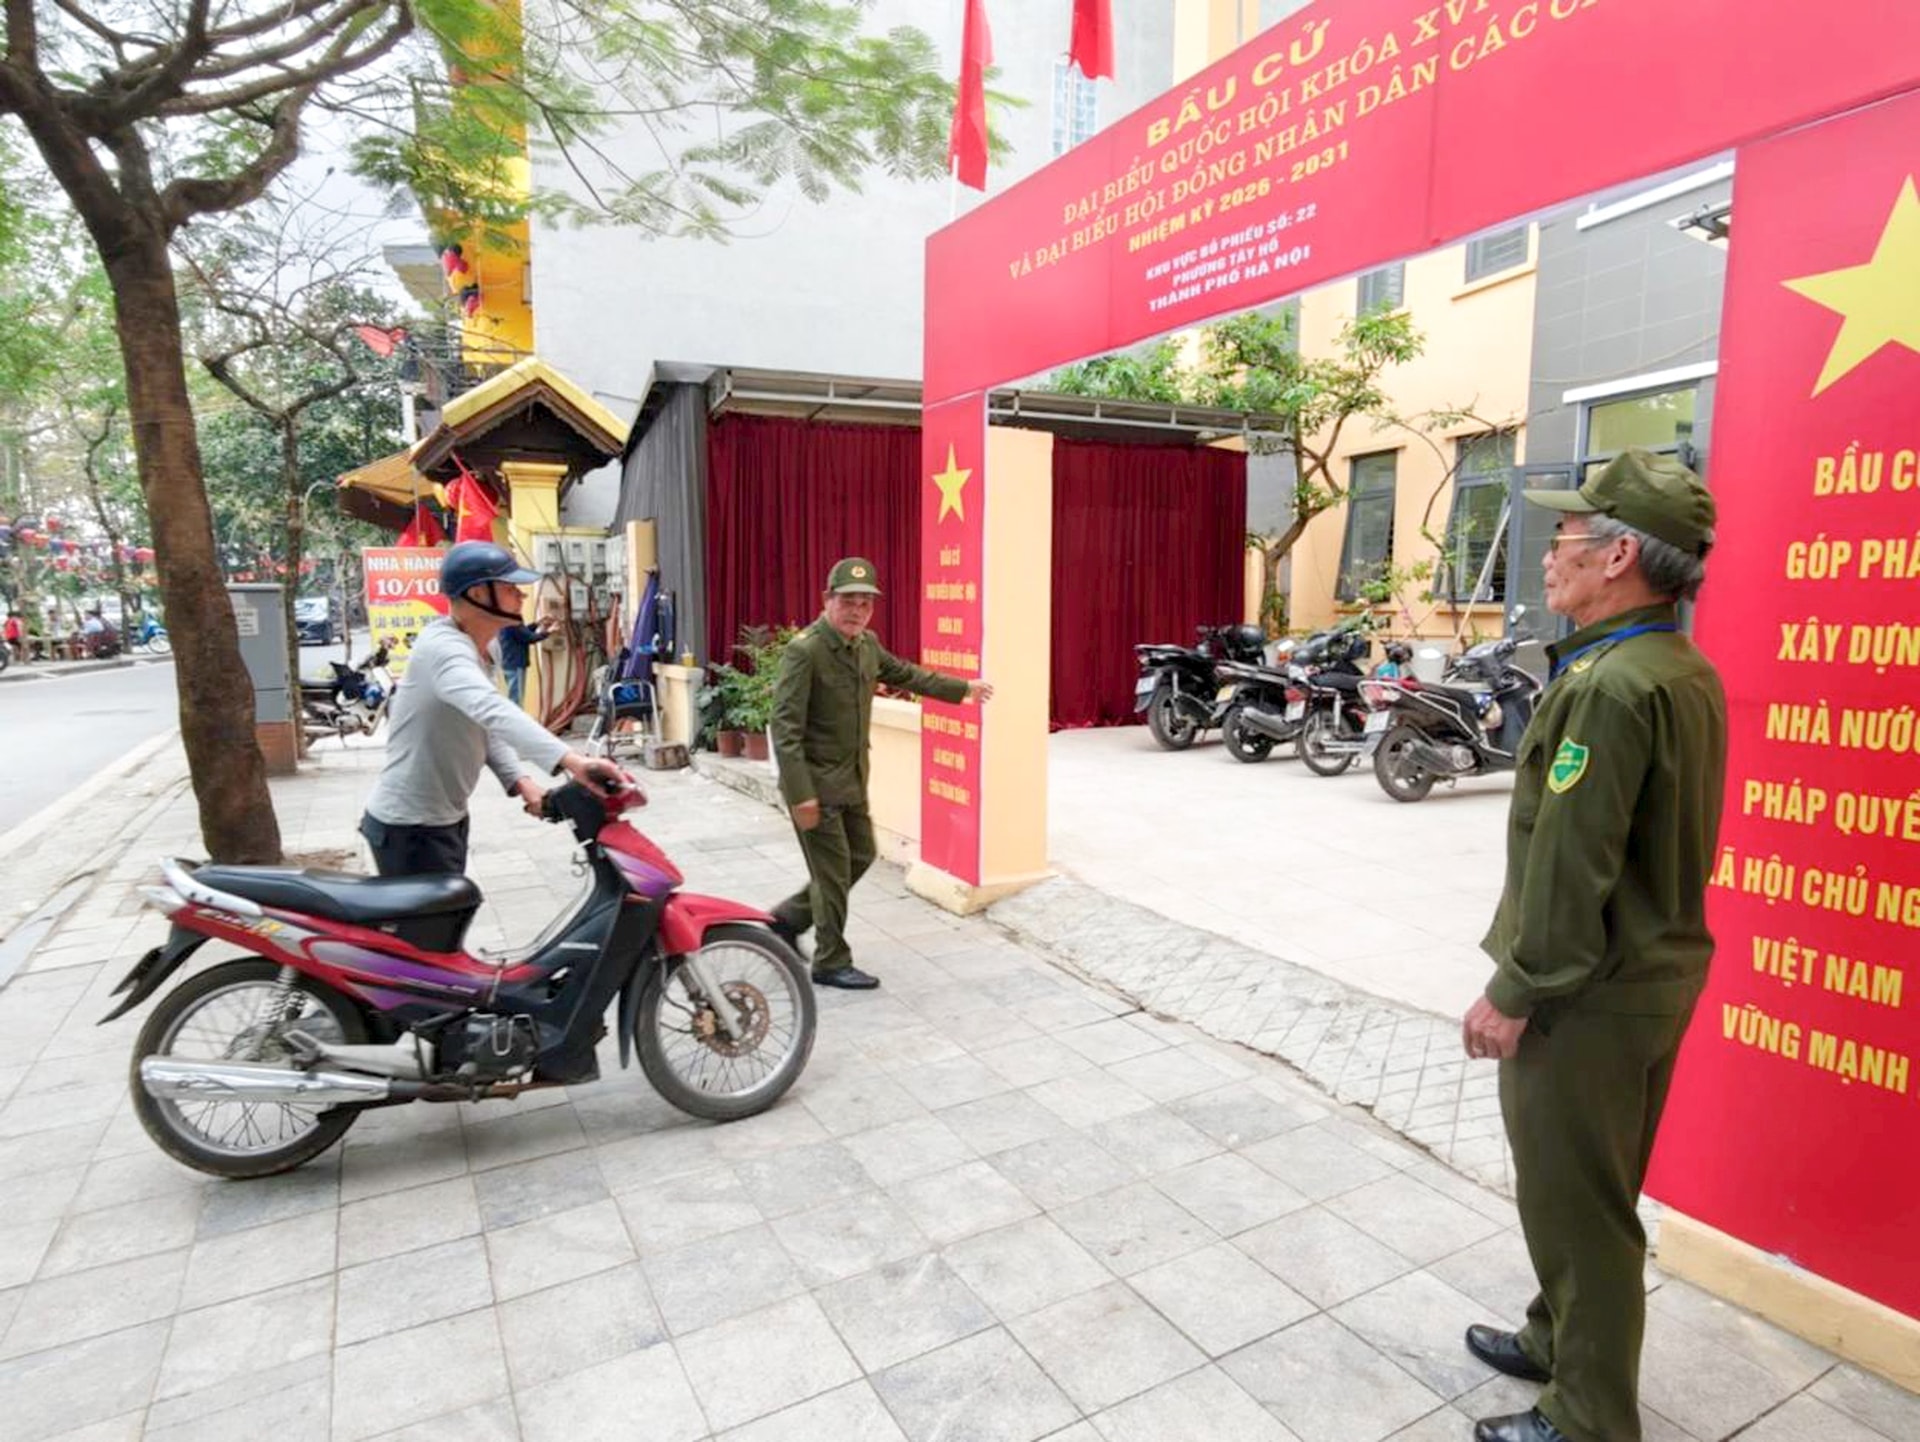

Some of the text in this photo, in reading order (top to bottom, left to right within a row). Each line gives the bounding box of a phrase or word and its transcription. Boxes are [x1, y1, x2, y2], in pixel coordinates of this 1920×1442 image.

[1146, 18, 1331, 148] BẦU CỬ
[1008, 252, 1033, 281] VÀ
[1035, 236, 1068, 268] ĐẠI
[1071, 205, 1119, 251] BIỂU
[1124, 189, 1166, 228] HỘI
[1171, 150, 1246, 205] ĐỒNG
[1253, 99, 1348, 167] NHÂN
[1355, 53, 1440, 118] DÂN
[1449, 3, 1538, 71] CÁC
[1063, 190, 1099, 226] ĐẠI
[1103, 155, 1155, 205] BIỂU
[1160, 116, 1231, 174] QUỐC
[1236, 88, 1291, 136] HỘI
[1300, 33, 1401, 104] KHÓA
[1128, 211, 1186, 253] NHIỆM
[1218, 177, 1271, 213] 2026
[1290, 140, 1349, 183] 2031
[1296, 203, 1317, 222] 22
[1244, 256, 1271, 280] HÀ
[1274, 243, 1312, 271] NỘI
[1813, 441, 1884, 496] BẦU
[1785, 532, 1851, 580] GÓP
[375, 577, 440, 597] 10/10
[1776, 615, 1843, 663] XÂY
[1765, 699, 1831, 746] NHÀ
[1742, 777, 1827, 825] PHÁP
[1708, 845, 1736, 890] Ã
[1742, 853, 1795, 906] HỘI
[1801, 863, 1869, 917] CHỦ
[1752, 934, 1903, 1008] VIỆT NAM
[1722, 1001, 1910, 1095] VỮNG MẠNH
